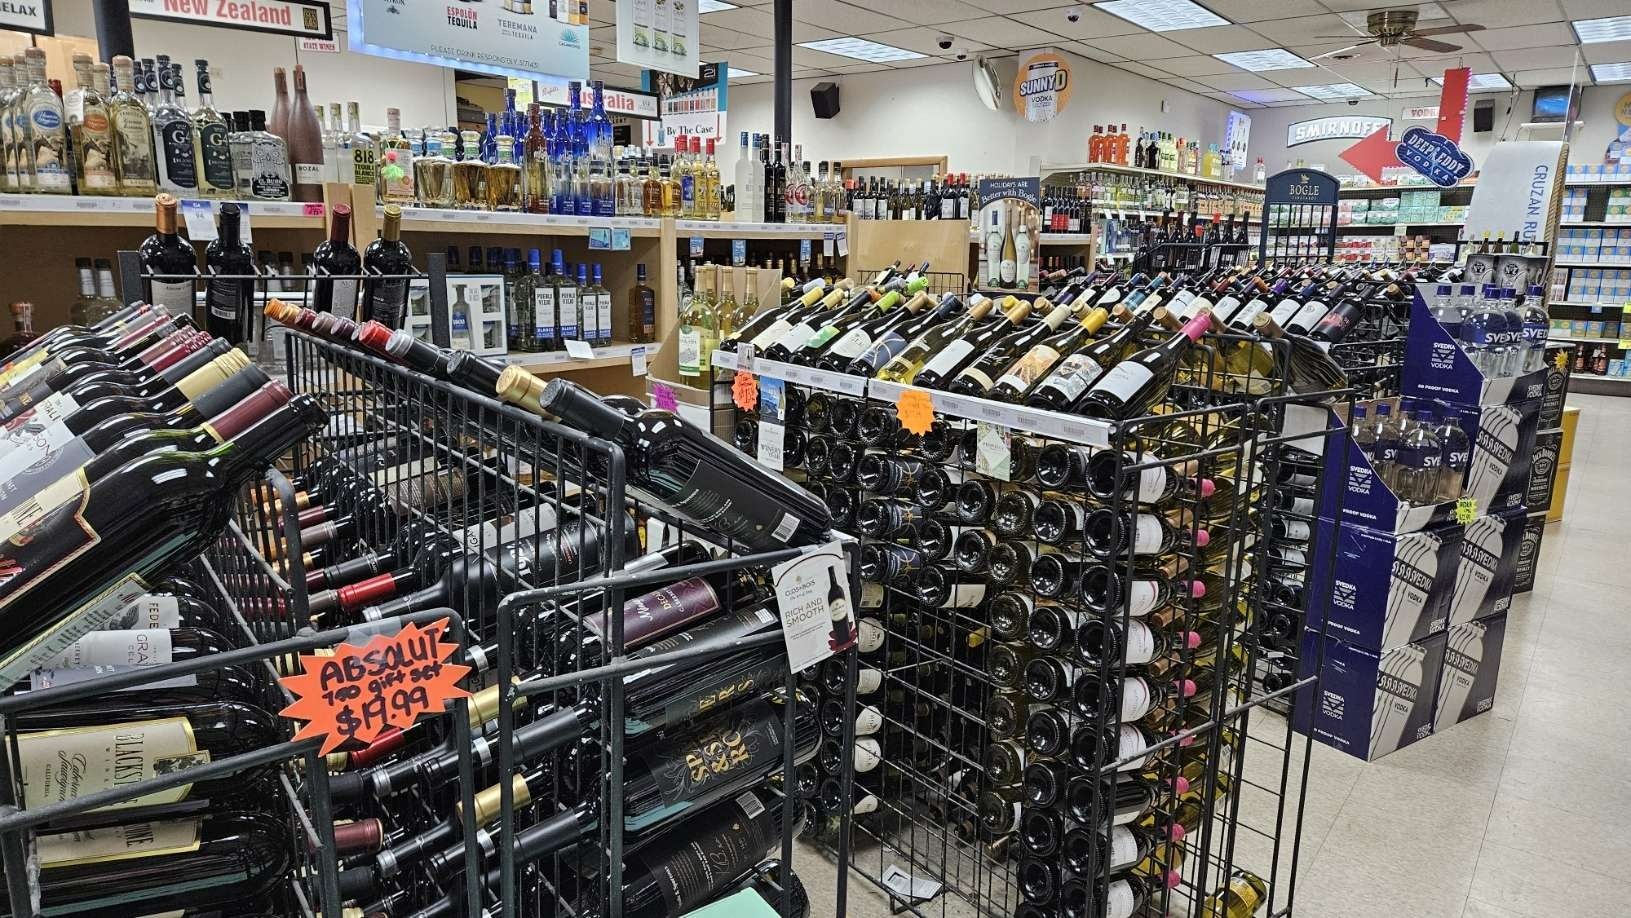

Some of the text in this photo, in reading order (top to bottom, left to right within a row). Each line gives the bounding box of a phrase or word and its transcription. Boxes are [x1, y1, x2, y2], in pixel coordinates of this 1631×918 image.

[164, 0, 292, 25] New Zealand
[447, 16, 478, 30] TEQUILA
[498, 18, 538, 34] TEREMANA
[679, 126, 693, 135] The
[695, 124, 714, 133] Case
[354, 149, 374, 164] 818
[1408, 134, 1465, 174] DEEP EDDY
[1406, 149, 1449, 180] VODKA
[990, 181, 1016, 189] HOLIDAYS
[1288, 184, 1320, 196] BOGLE
[1527, 165, 1549, 215] CRUZAN
[1522, 221, 1538, 241] RU
[1431, 362, 1453, 370] VODKA
[1348, 486, 1370, 495] VODKA
[784, 597, 823, 620] RICH AND
[1333, 598, 1354, 611] VODKA
[786, 605, 825, 628] SMOOTH
[320, 627, 440, 690] ABSOLUT
[367, 669, 406, 698] gift
[409, 660, 443, 683] set
[335, 686, 430, 737] $19.99
[1322, 709, 1344, 721] VODKA
